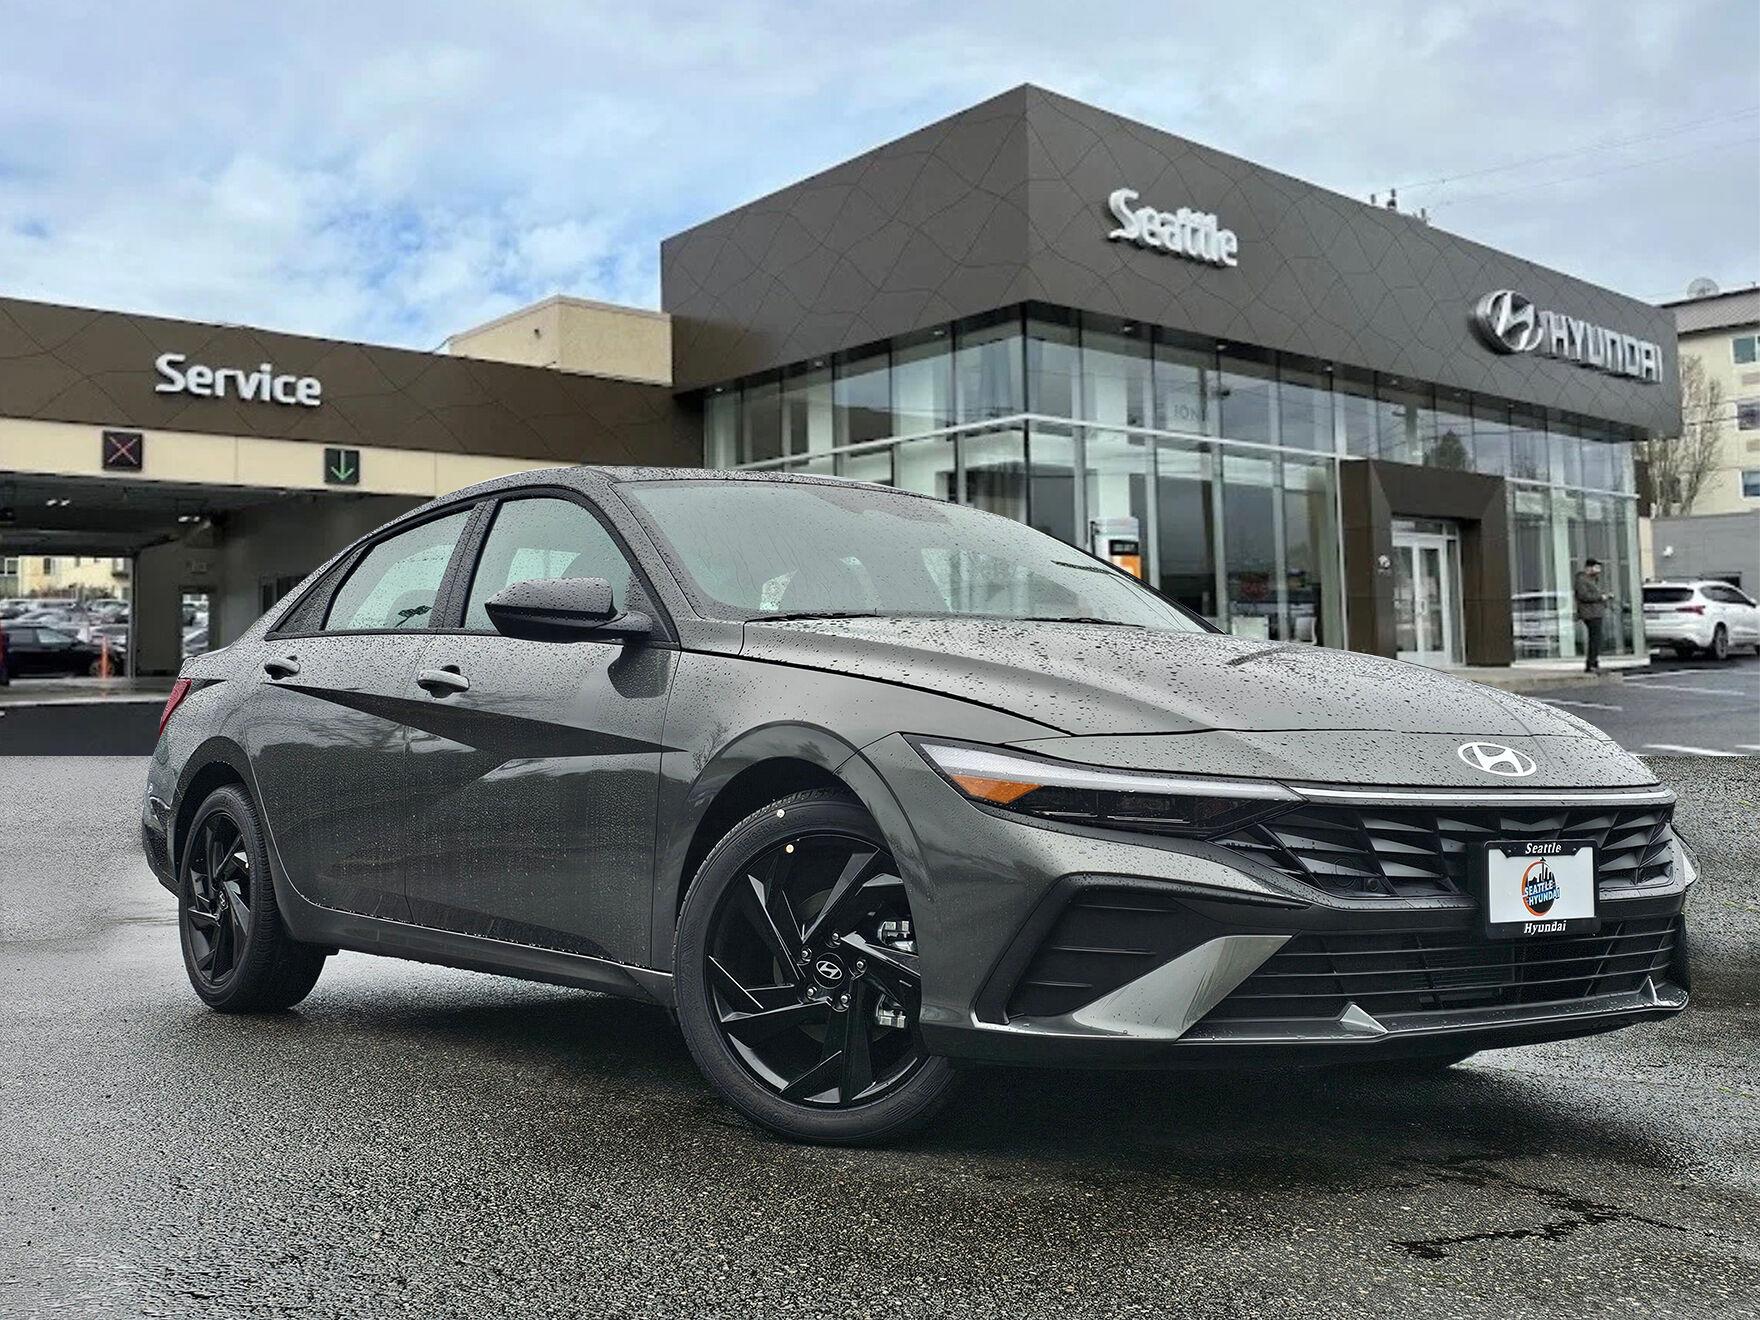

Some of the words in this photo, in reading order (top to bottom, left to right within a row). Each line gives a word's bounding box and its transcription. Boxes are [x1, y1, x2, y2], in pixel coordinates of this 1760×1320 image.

[1109, 188, 1238, 267] Seattle
[1542, 311, 1662, 383] HYUNDAI
[155, 353, 322, 406] Service
[1525, 843, 1562, 854] Seattle
[1524, 879, 1554, 897] SEATTLE
[1528, 887, 1561, 905] HYUNDAI
[1524, 920, 1566, 935] Hyundai
